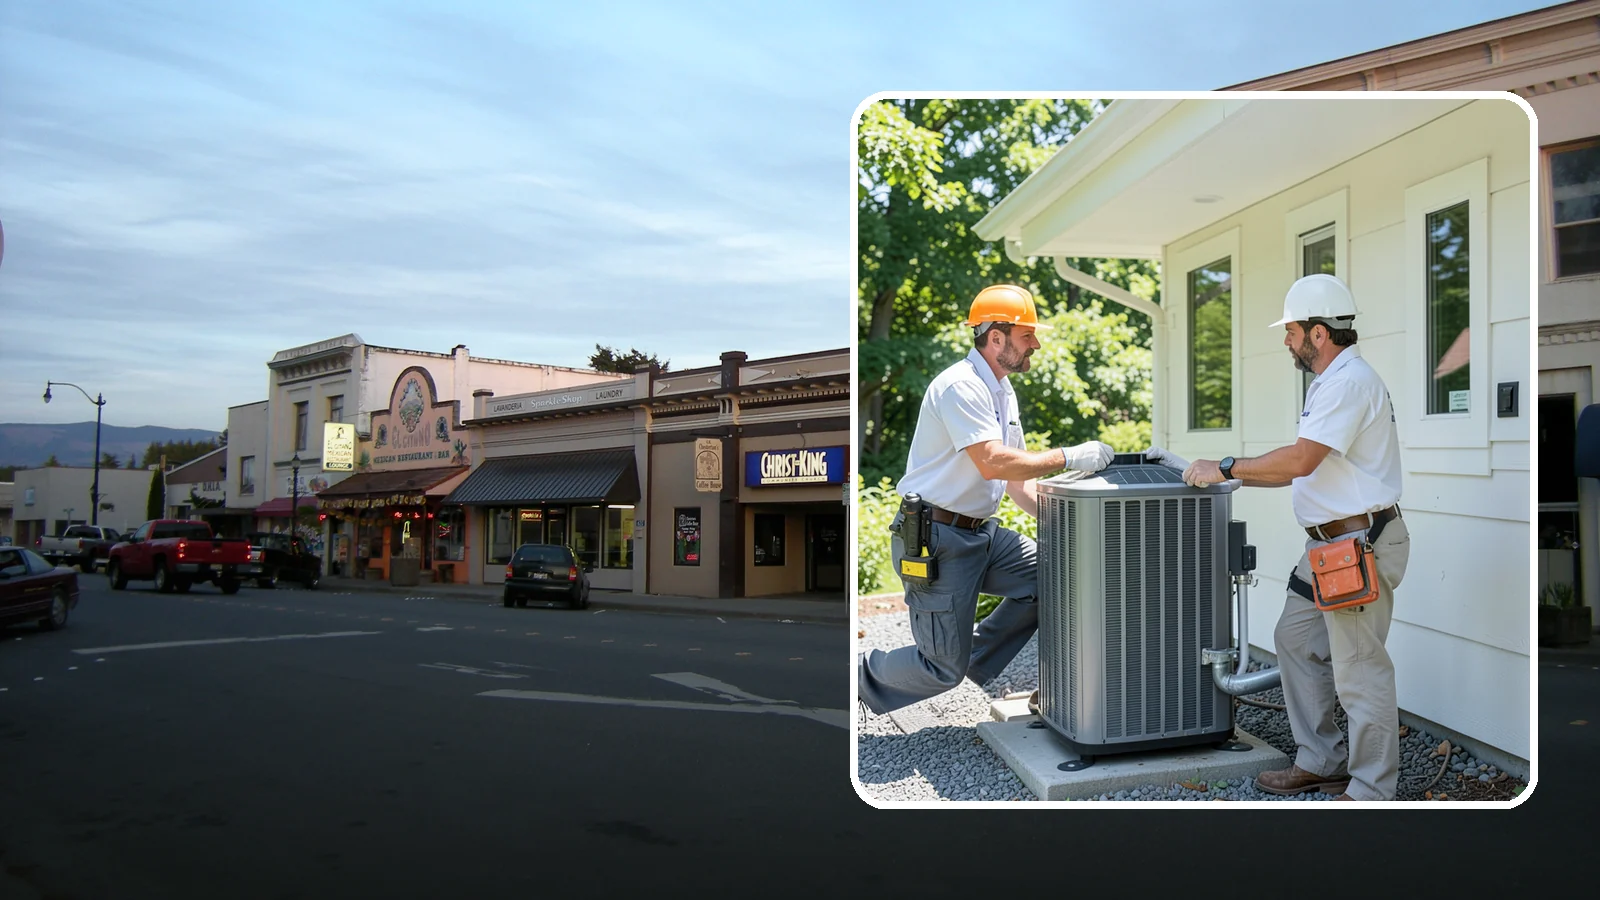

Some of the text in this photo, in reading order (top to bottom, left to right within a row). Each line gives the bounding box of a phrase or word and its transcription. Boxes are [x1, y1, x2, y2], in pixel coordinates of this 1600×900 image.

[530, 394, 583, 409] Sparkle Shop
[595, 389, 623, 400] LAUNDRY
[493, 402, 523, 413] LAVANDERIA
[374, 454, 397, 465] MEXICAN
[397, 451, 433, 463] RESTAURANT
[438, 450, 450, 460] BAR
[760, 449, 828, 478] CHRIST KING
